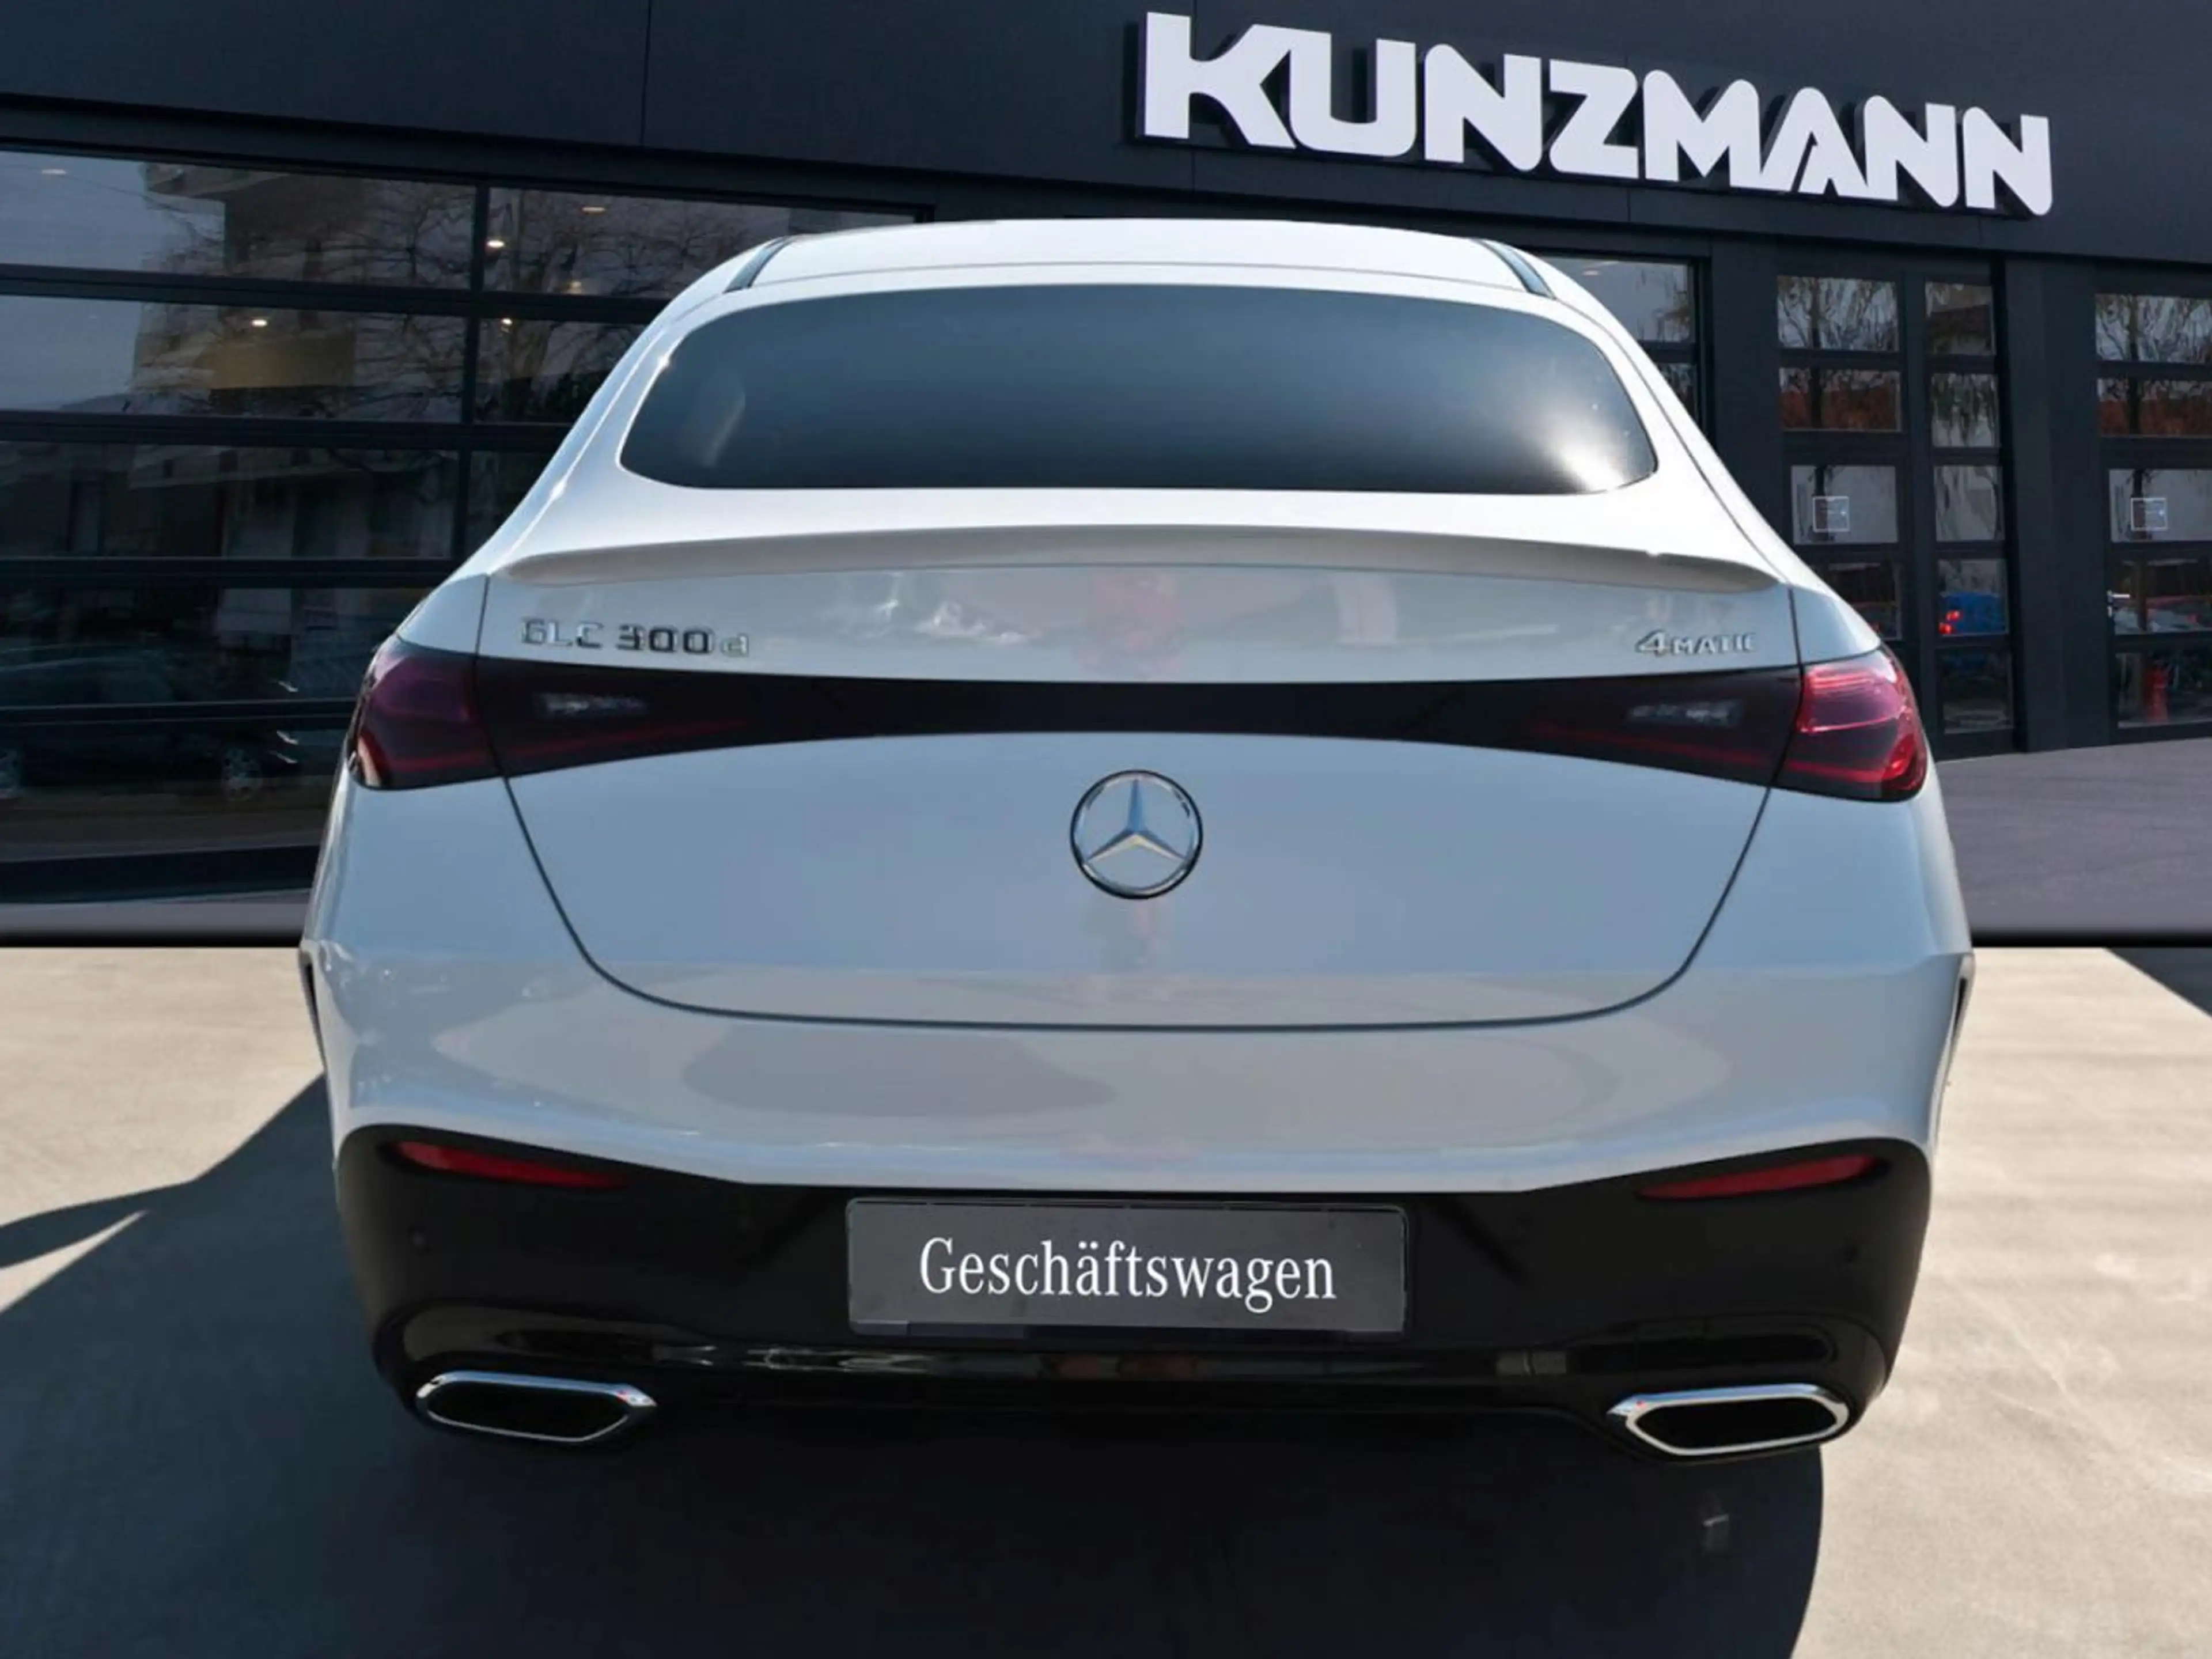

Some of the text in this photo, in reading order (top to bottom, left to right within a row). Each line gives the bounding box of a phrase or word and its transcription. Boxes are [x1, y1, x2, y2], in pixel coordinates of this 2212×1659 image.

[1145, 10, 2053, 217] KUNZMANN
[521, 618, 604, 649] GLC
[919, 1237, 1336, 1313] Geschäftswagen
